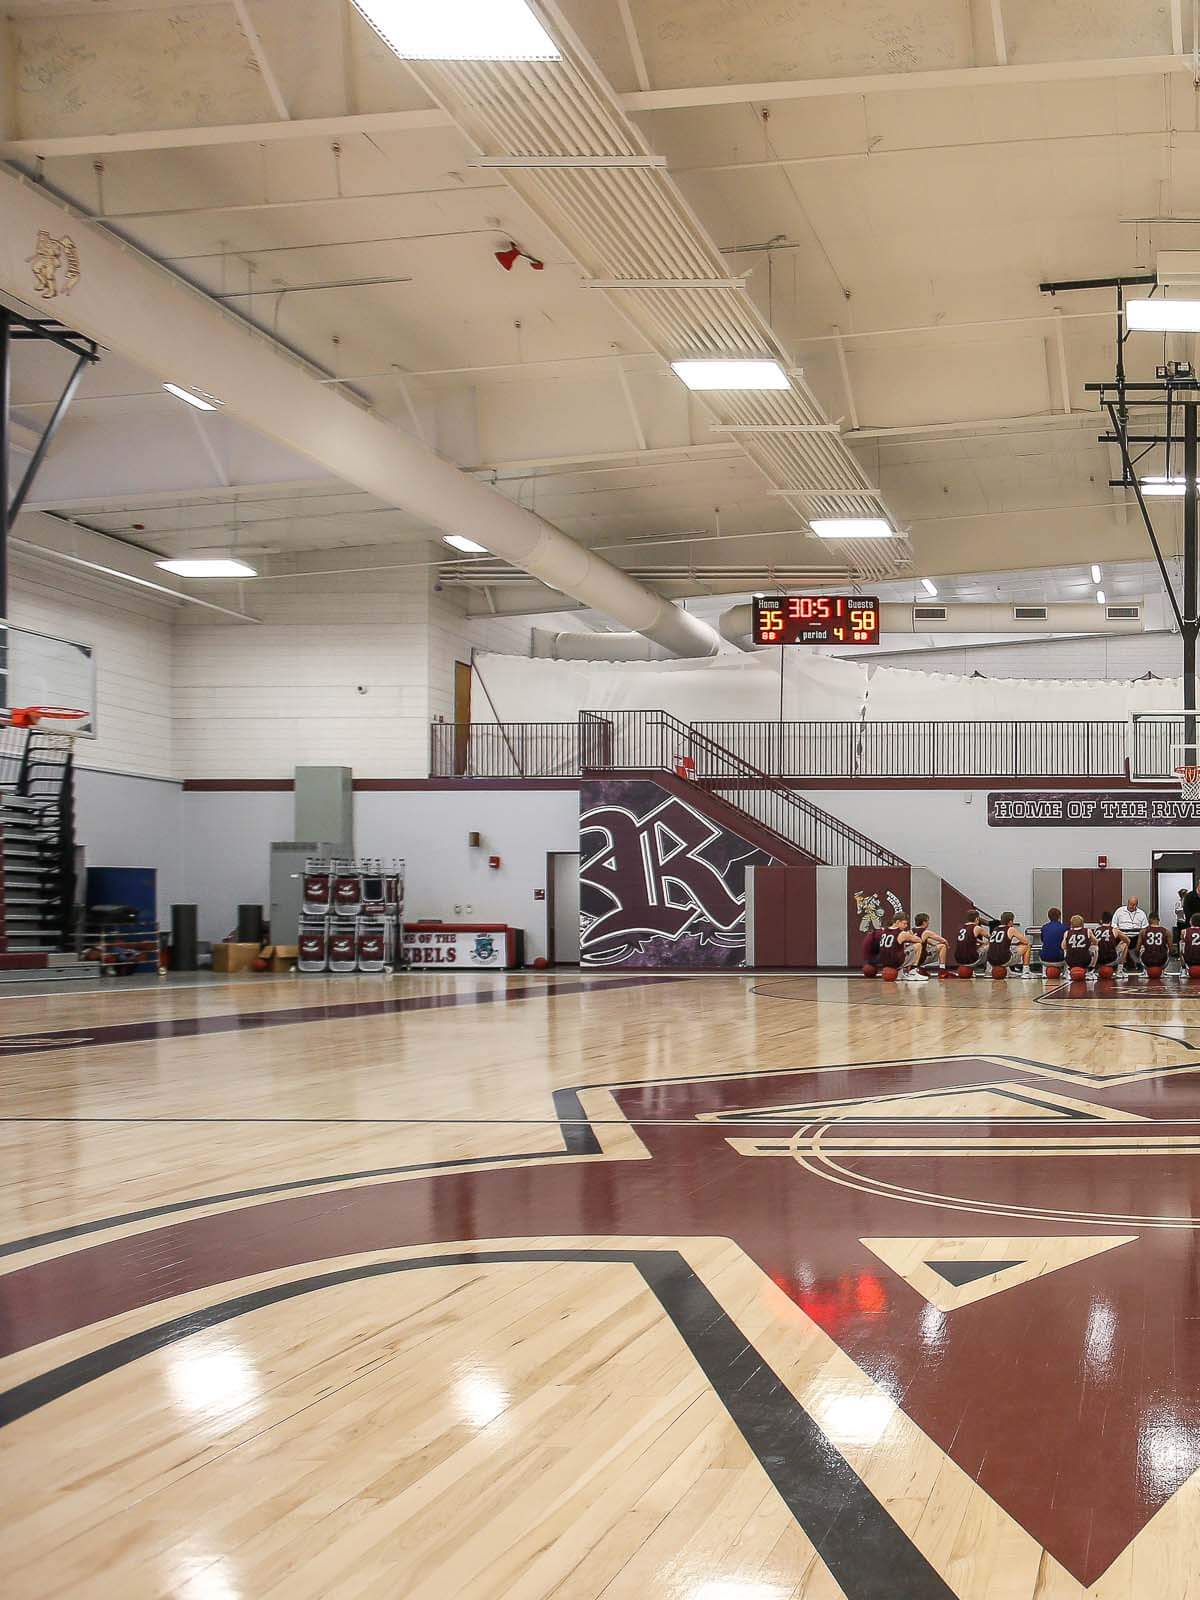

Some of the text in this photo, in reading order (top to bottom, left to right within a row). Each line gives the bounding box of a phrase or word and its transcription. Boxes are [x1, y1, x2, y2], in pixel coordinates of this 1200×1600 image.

[758, 600, 779, 609] Home
[788, 598, 842, 618] 30:51
[848, 599, 874, 609] Guests
[759, 611, 783, 631] 35
[850, 611, 875, 631] 58
[802, 630, 827, 640] period
[833, 628, 844, 641] 4
[994, 800, 1062, 818] HOME
[1067, 800, 1097, 818] OF
[1101, 800, 1148, 818] THE
[418, 934, 432, 944] OF
[435, 934, 457, 944] THE
[957, 928, 967, 942] 3
[989, 930, 1005, 943] 20
[1068, 934, 1087, 948] 42
[1095, 929, 1111, 942] 24
[1146, 932, 1163, 945] 33
[1191, 932, 1200, 946] 2
[402, 947, 456, 963] EBELS
